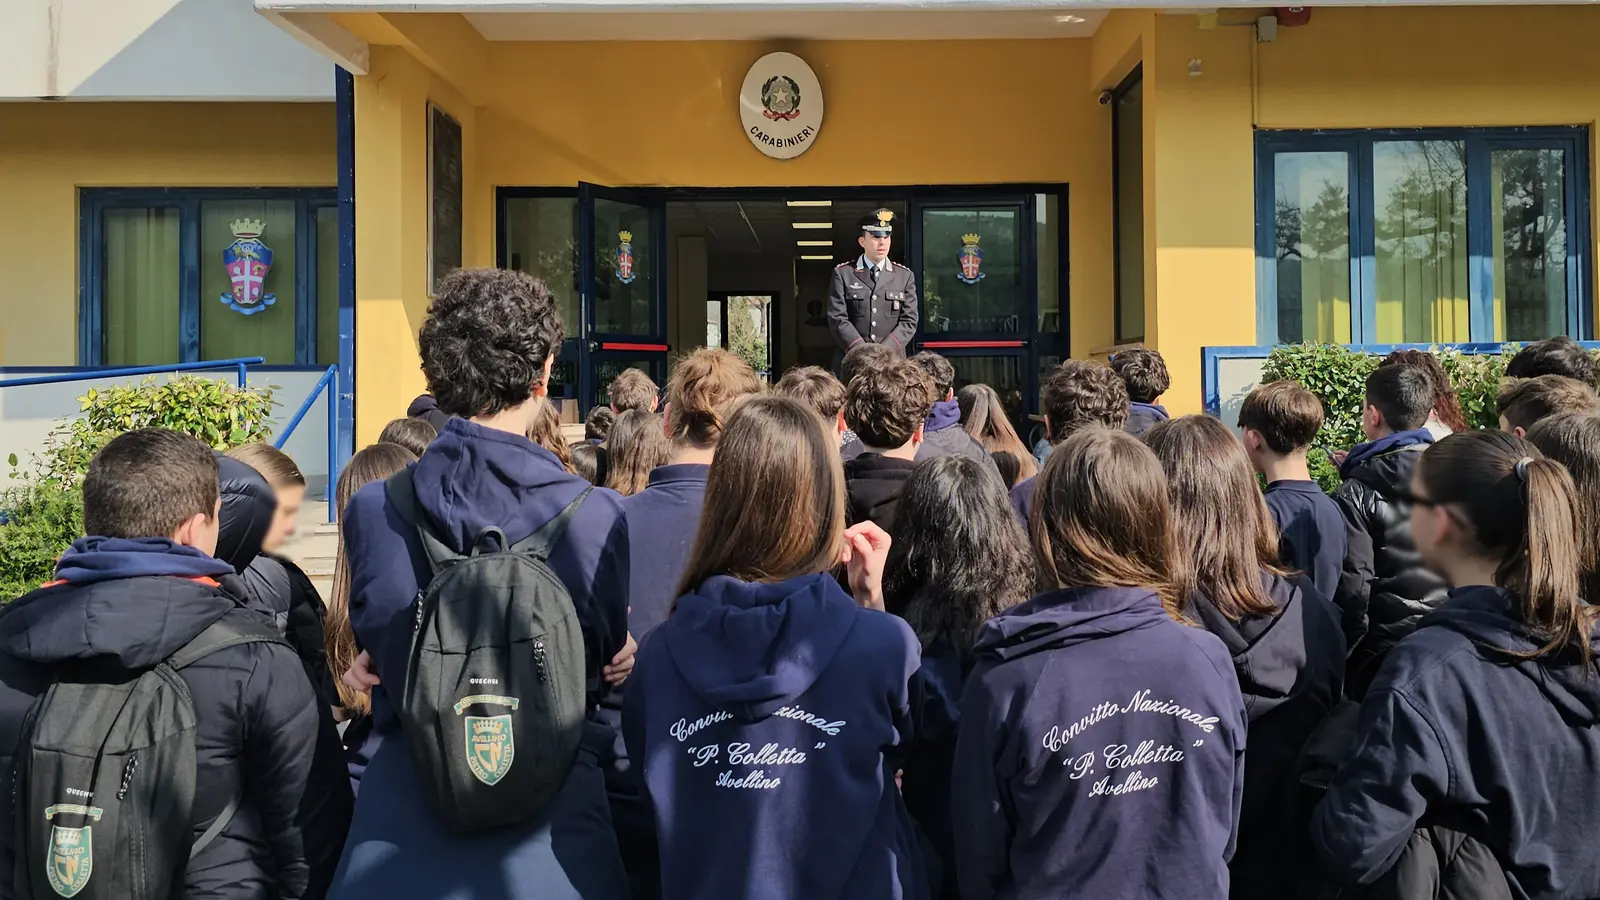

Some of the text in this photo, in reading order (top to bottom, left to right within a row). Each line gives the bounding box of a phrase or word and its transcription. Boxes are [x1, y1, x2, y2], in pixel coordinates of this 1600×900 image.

[750, 125, 815, 148] CARABINIERI
[670, 704, 846, 742] Convi zionale
[1042, 689, 1220, 752] Convitto Nazionale
[728, 742, 807, 766] Colletta
[1103, 739, 1184, 769] Colletta
[715, 769, 781, 790] Avellino
[1088, 770, 1159, 797] Avellino
[66, 787, 94, 798] QUECHU
